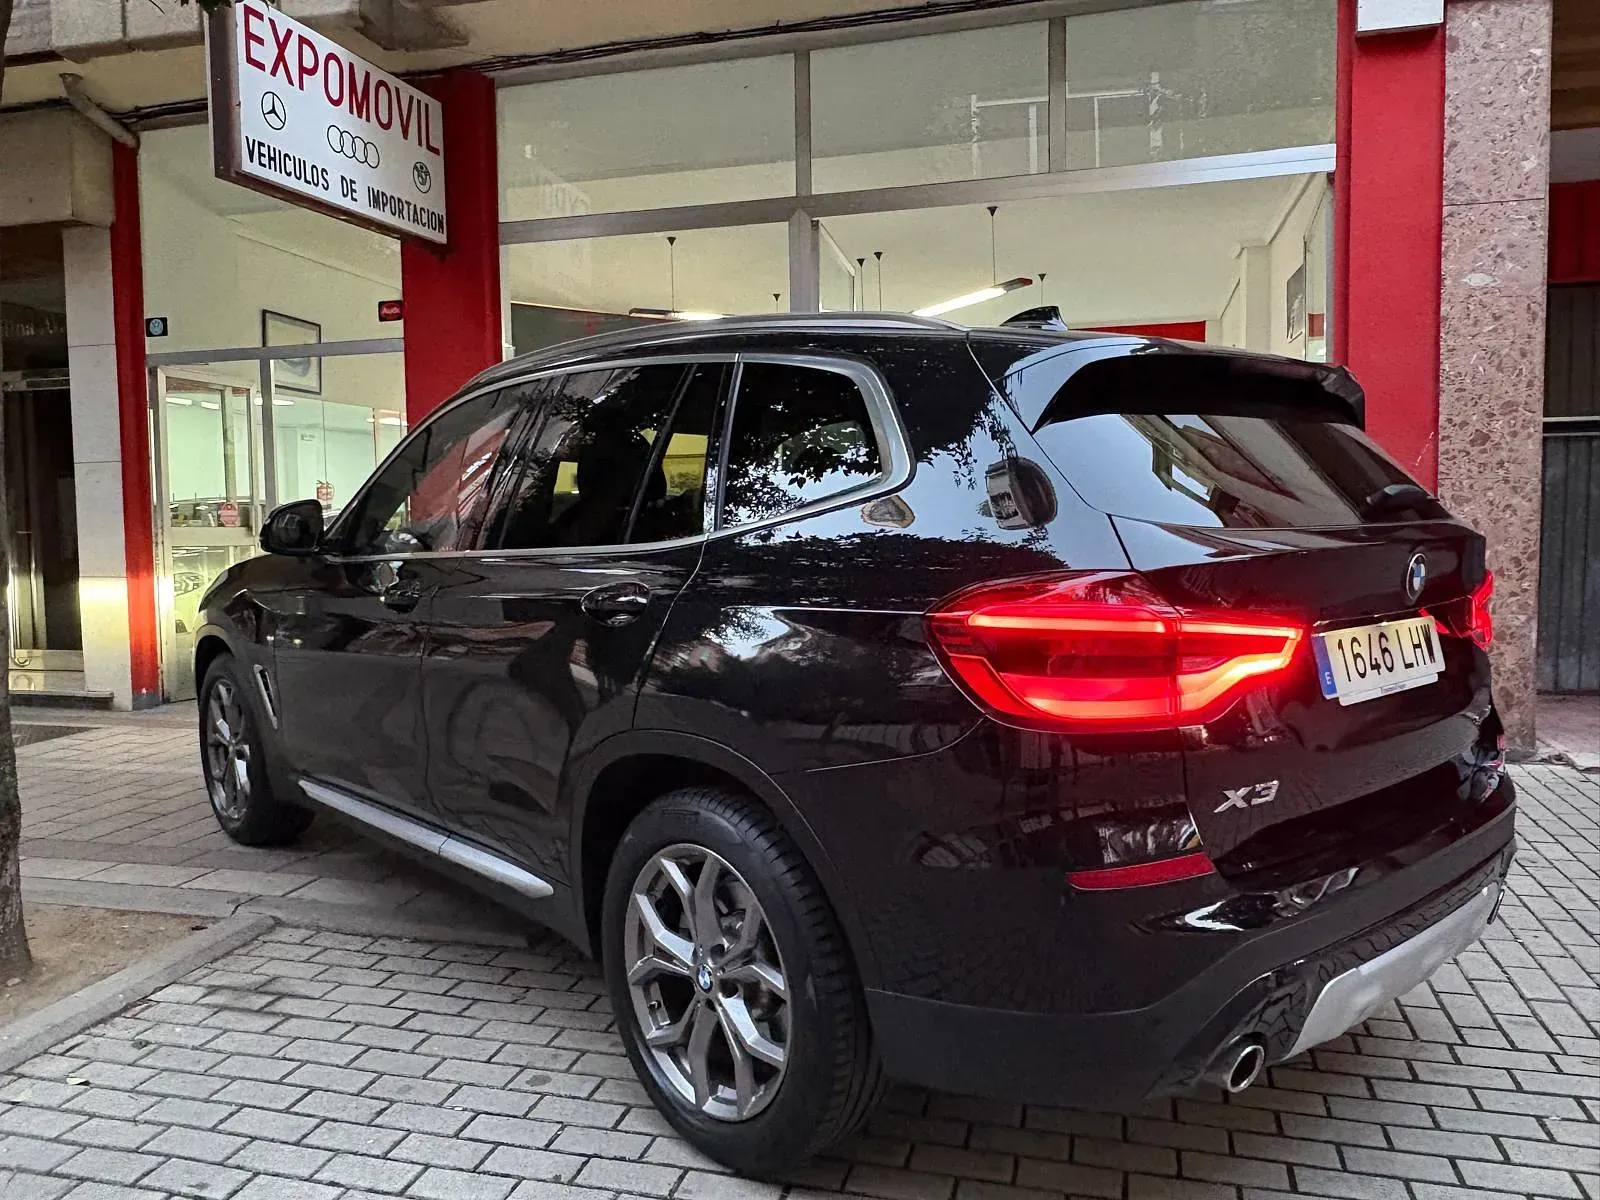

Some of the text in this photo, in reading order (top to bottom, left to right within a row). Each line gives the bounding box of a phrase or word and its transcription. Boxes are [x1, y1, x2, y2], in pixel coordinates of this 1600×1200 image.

[243, 3, 440, 156] EXPOMOVIL
[245, 135, 444, 235] VEHICULOS DE IMPORTACION
[1324, 671, 1332, 685] E
[1337, 624, 1436, 682] 1646 LHW
[1213, 780, 1279, 813] X3
